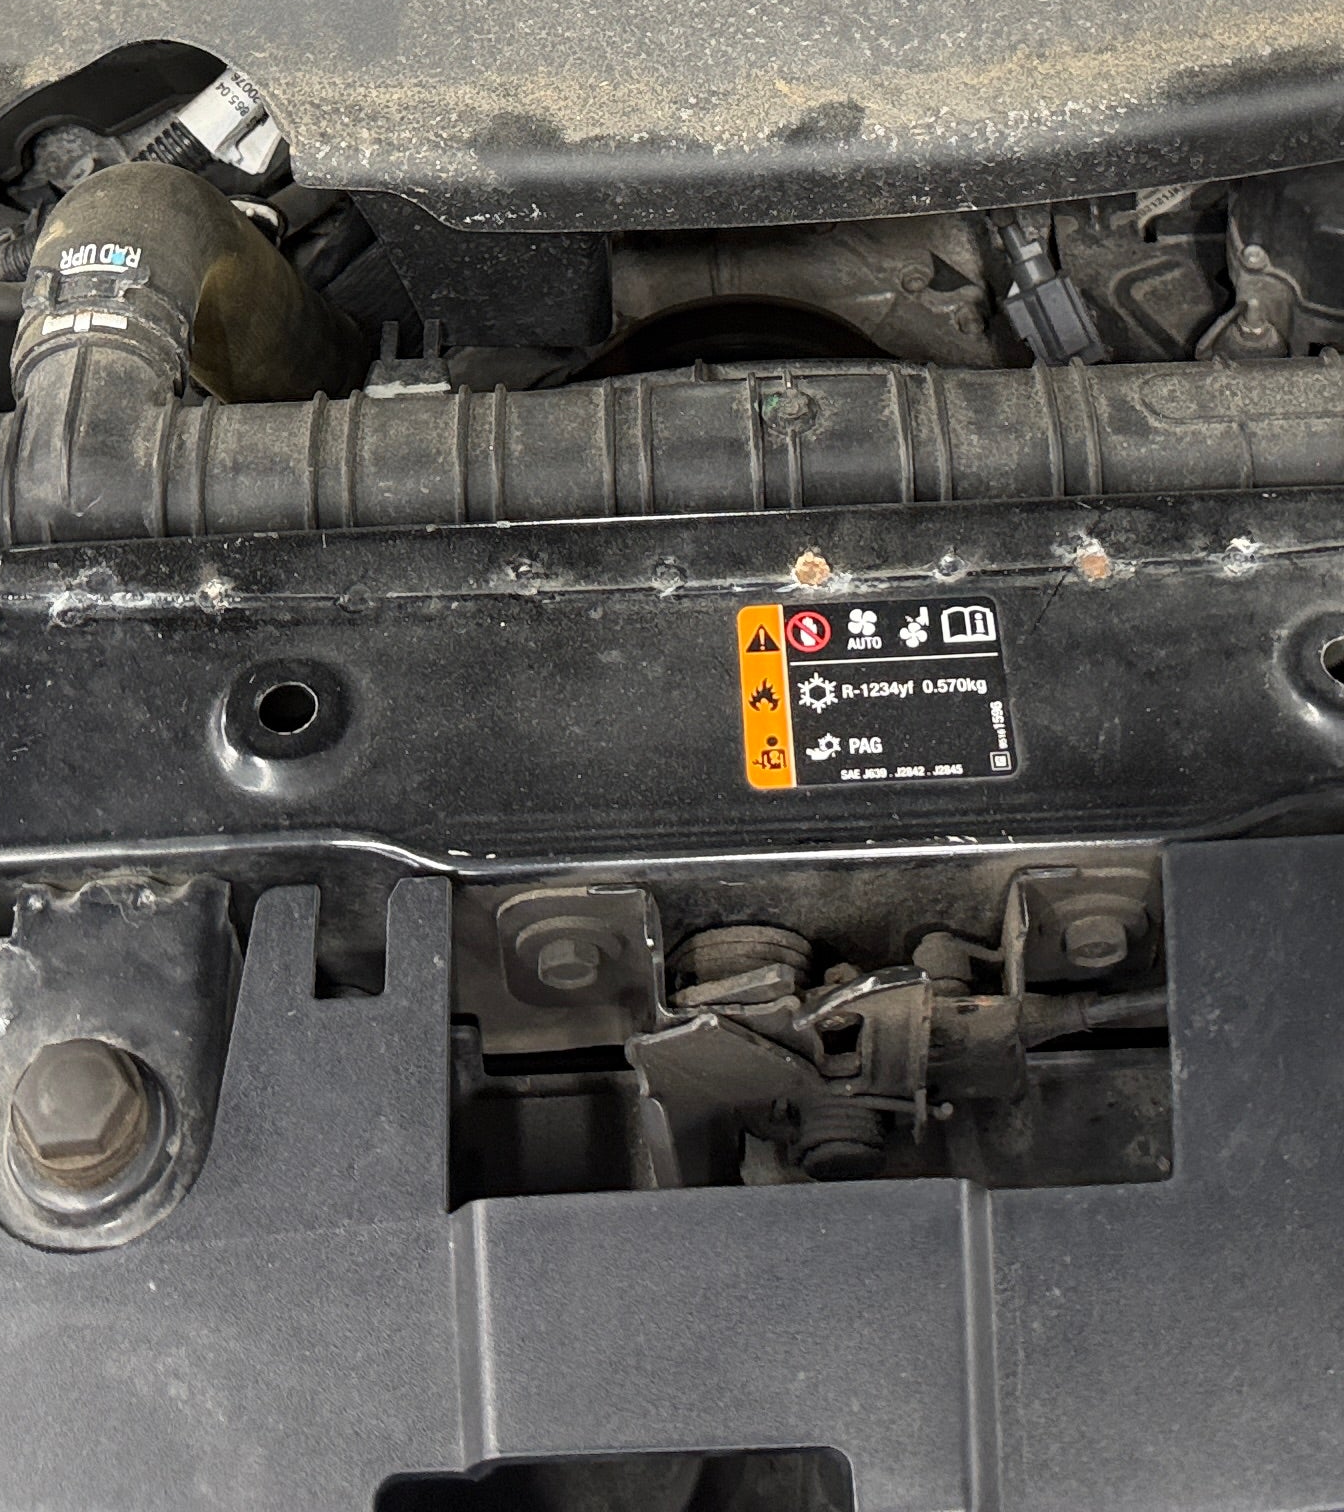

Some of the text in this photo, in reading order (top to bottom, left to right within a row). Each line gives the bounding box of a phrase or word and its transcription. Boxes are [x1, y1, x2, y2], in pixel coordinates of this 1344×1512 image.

[60, 244, 97, 269] UPR
[847, 637, 882, 651] AUTO
[841, 678, 987, 700] R-1234yf 0.570kg
[849, 737, 883, 755] PAG
[840, 768, 861, 781] SAE
